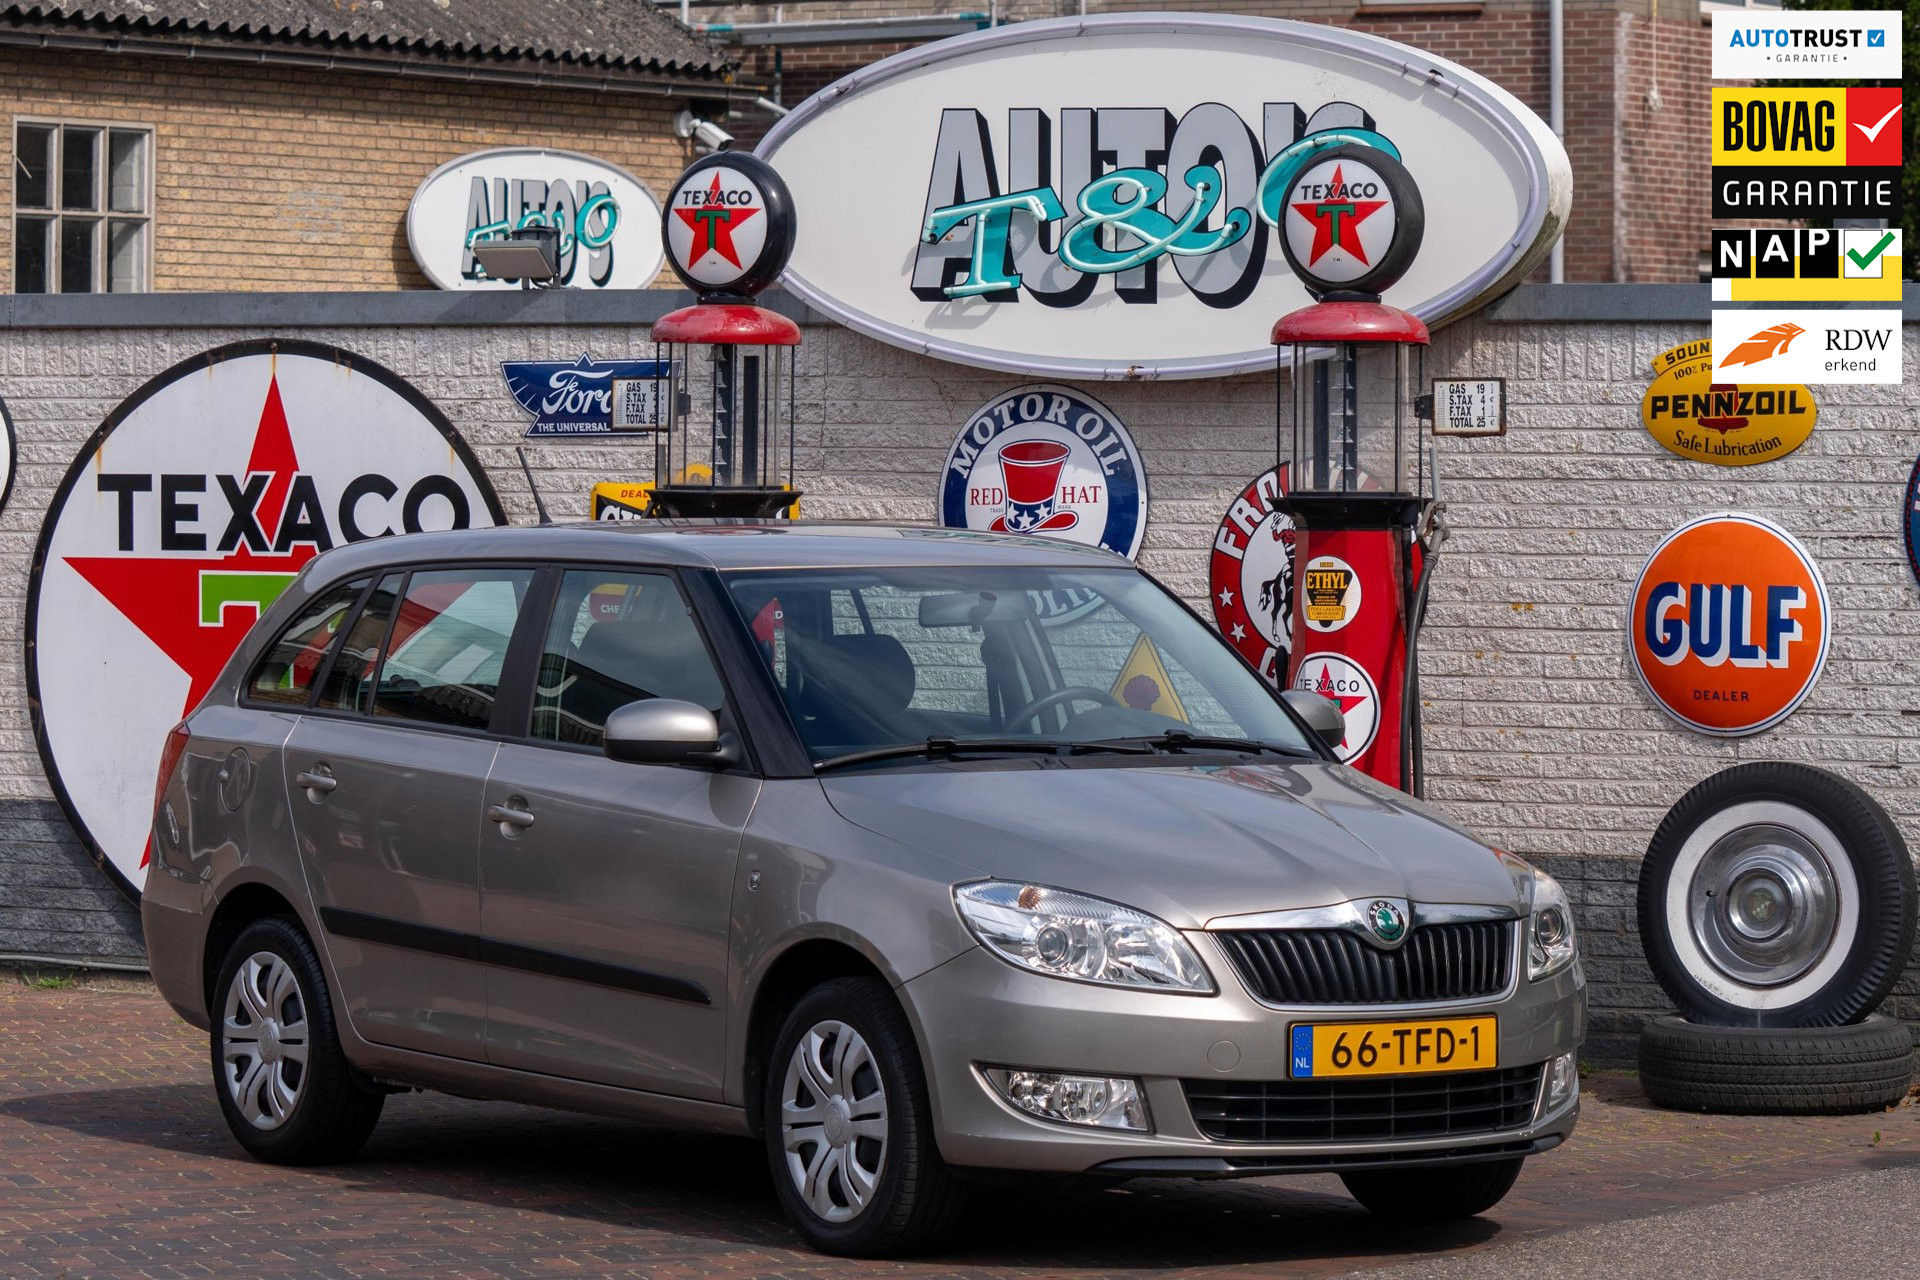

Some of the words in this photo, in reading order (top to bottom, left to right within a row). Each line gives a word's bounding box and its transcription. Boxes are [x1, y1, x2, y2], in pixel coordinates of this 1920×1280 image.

[682, 190, 752, 206] TEXACO
[1301, 182, 1378, 200] TEXACO
[1665, 341, 1710, 366] SOUN
[1674, 365, 1697, 380] 100%
[626, 382, 641, 393] GAS
[1449, 384, 1466, 394] GAS
[1477, 384, 1485, 394] 19
[626, 393, 646, 403] S.TAX
[1449, 395, 1473, 405] S.TAX
[1480, 395, 1485, 405] 4
[1651, 390, 1807, 419] PENNZOIL
[626, 403, 645, 413] F.TAX
[1449, 406, 1472, 416] F.TAX
[1481, 406, 1485, 416] 1
[626, 414, 646, 424] TOTAL
[1449, 417, 1474, 428] TOTAL
[1476, 417, 1486, 428] 25
[537, 423, 555, 432] THE
[557, 423, 610, 432] UNIVERSAL
[950, 394, 1071, 479] MOTOR
[1076, 412, 1128, 477] OIL
[1673, 430, 1702, 451] Safe
[1705, 436, 1782, 456] Lubrication
[970, 488, 1003, 505] RED
[1061, 486, 1101, 503] HAT
[97, 473, 470, 552] TEXACO
[1306, 572, 1347, 589] ETHYL
[1645, 581, 1807, 669] GULF
[1693, 690, 1750, 702] DEALER
[1331, 1025, 1480, 1069] 66-TFD-1
[1295, 1057, 1310, 1068] NL
